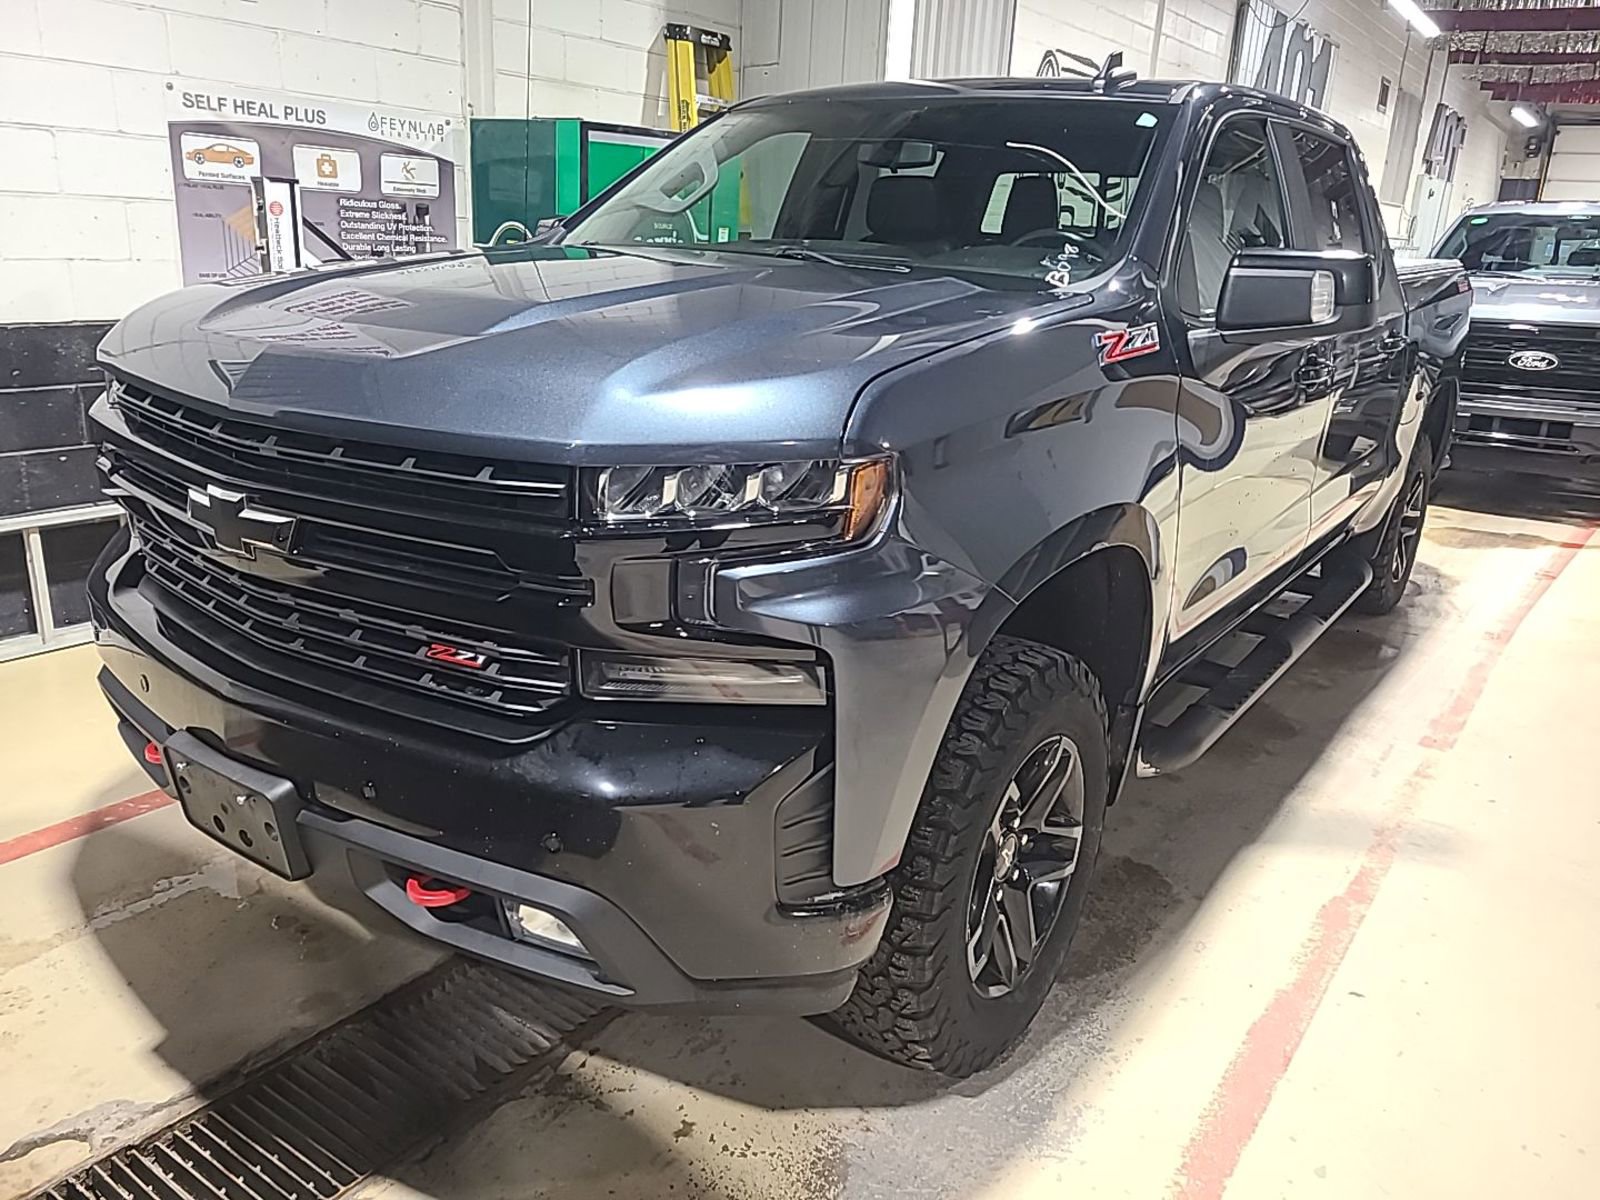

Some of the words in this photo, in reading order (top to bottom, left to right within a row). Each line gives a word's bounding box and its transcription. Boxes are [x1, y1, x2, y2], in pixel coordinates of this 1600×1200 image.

[182, 92, 227, 112] SELF
[233, 99, 279, 119] HEAL
[284, 105, 326, 125] PLUS
[380, 116, 444, 136] FEYNLAB
[339, 198, 377, 208] Ridiculous
[340, 209, 370, 219] Extreme
[340, 220, 385, 231] Outstanding
[341, 231, 375, 241] Excellent
[376, 233, 408, 242] Chemical
[342, 242, 371, 251] Durable
[372, 245, 389, 253] Long
[391, 245, 417, 254] Lasting
[1099, 322, 1160, 367] Z71
[1517, 356, 1550, 368] Ford
[427, 643, 487, 668] Z71
